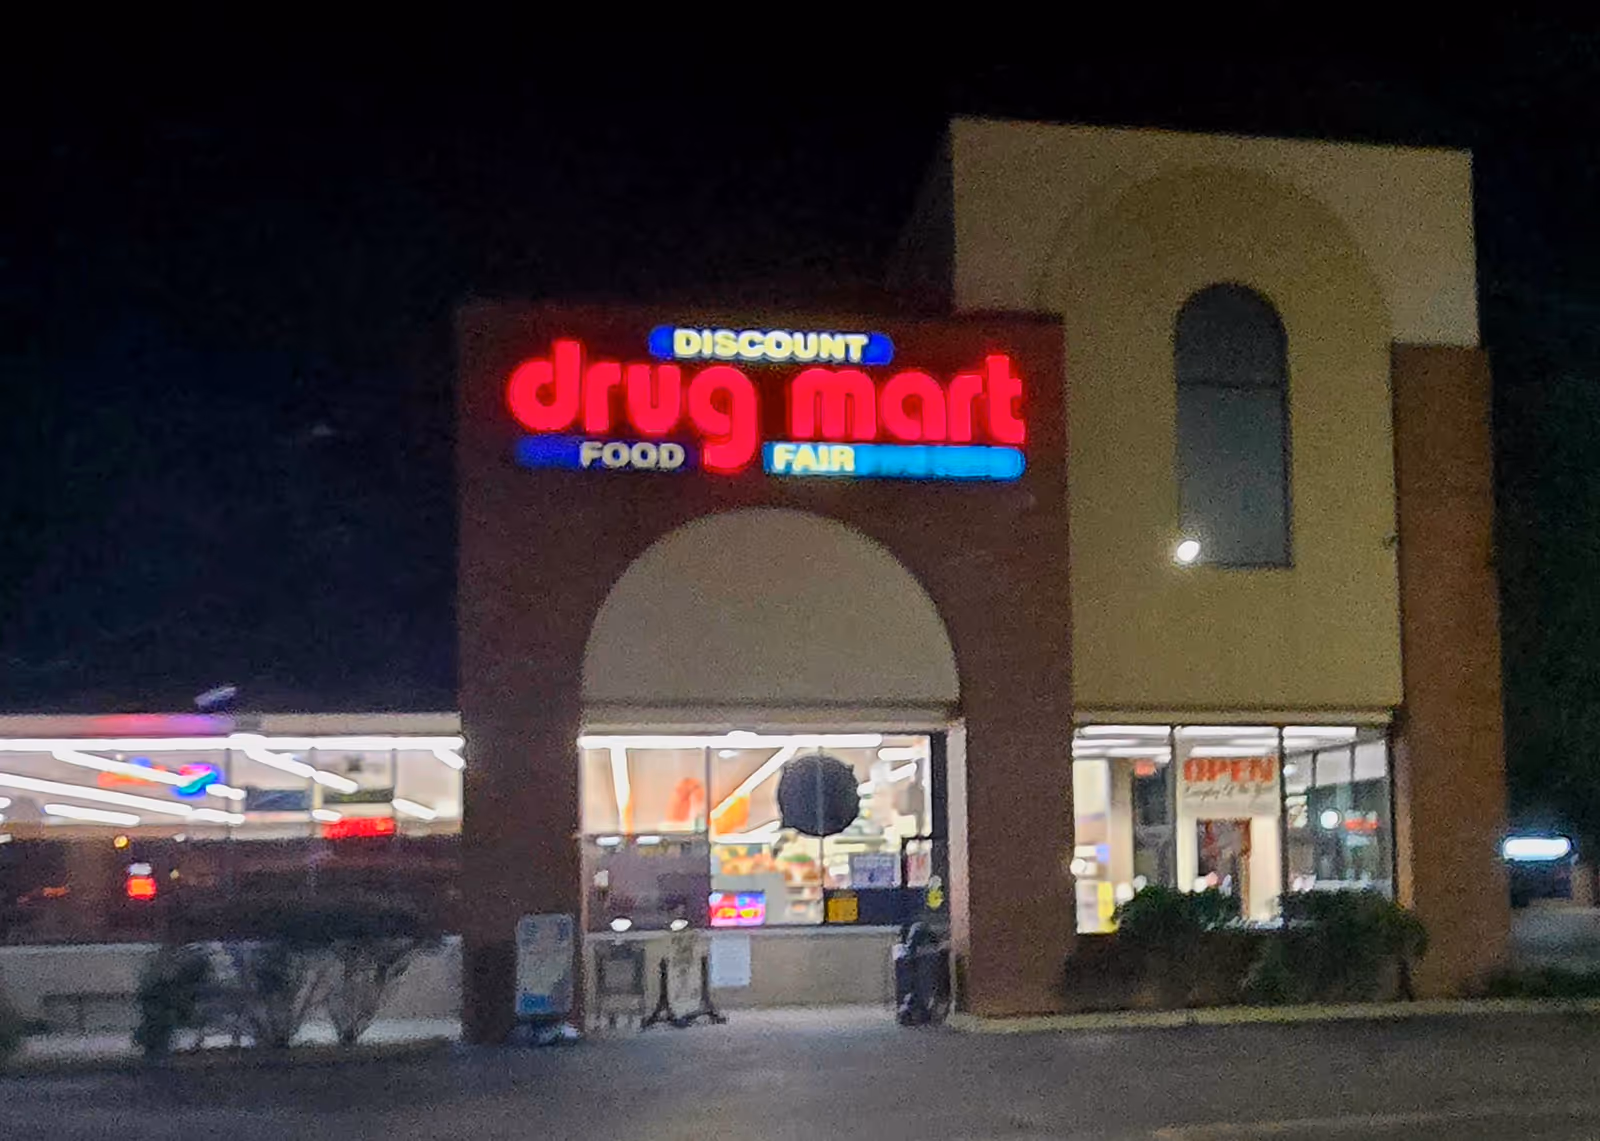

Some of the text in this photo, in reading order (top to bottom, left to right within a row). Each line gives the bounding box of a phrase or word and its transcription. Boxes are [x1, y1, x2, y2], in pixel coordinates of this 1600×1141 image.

[673, 328, 869, 363] DISCOUNT
[508, 339, 1025, 474] drug mart
[579, 440, 856, 475] FOOD FAIR
